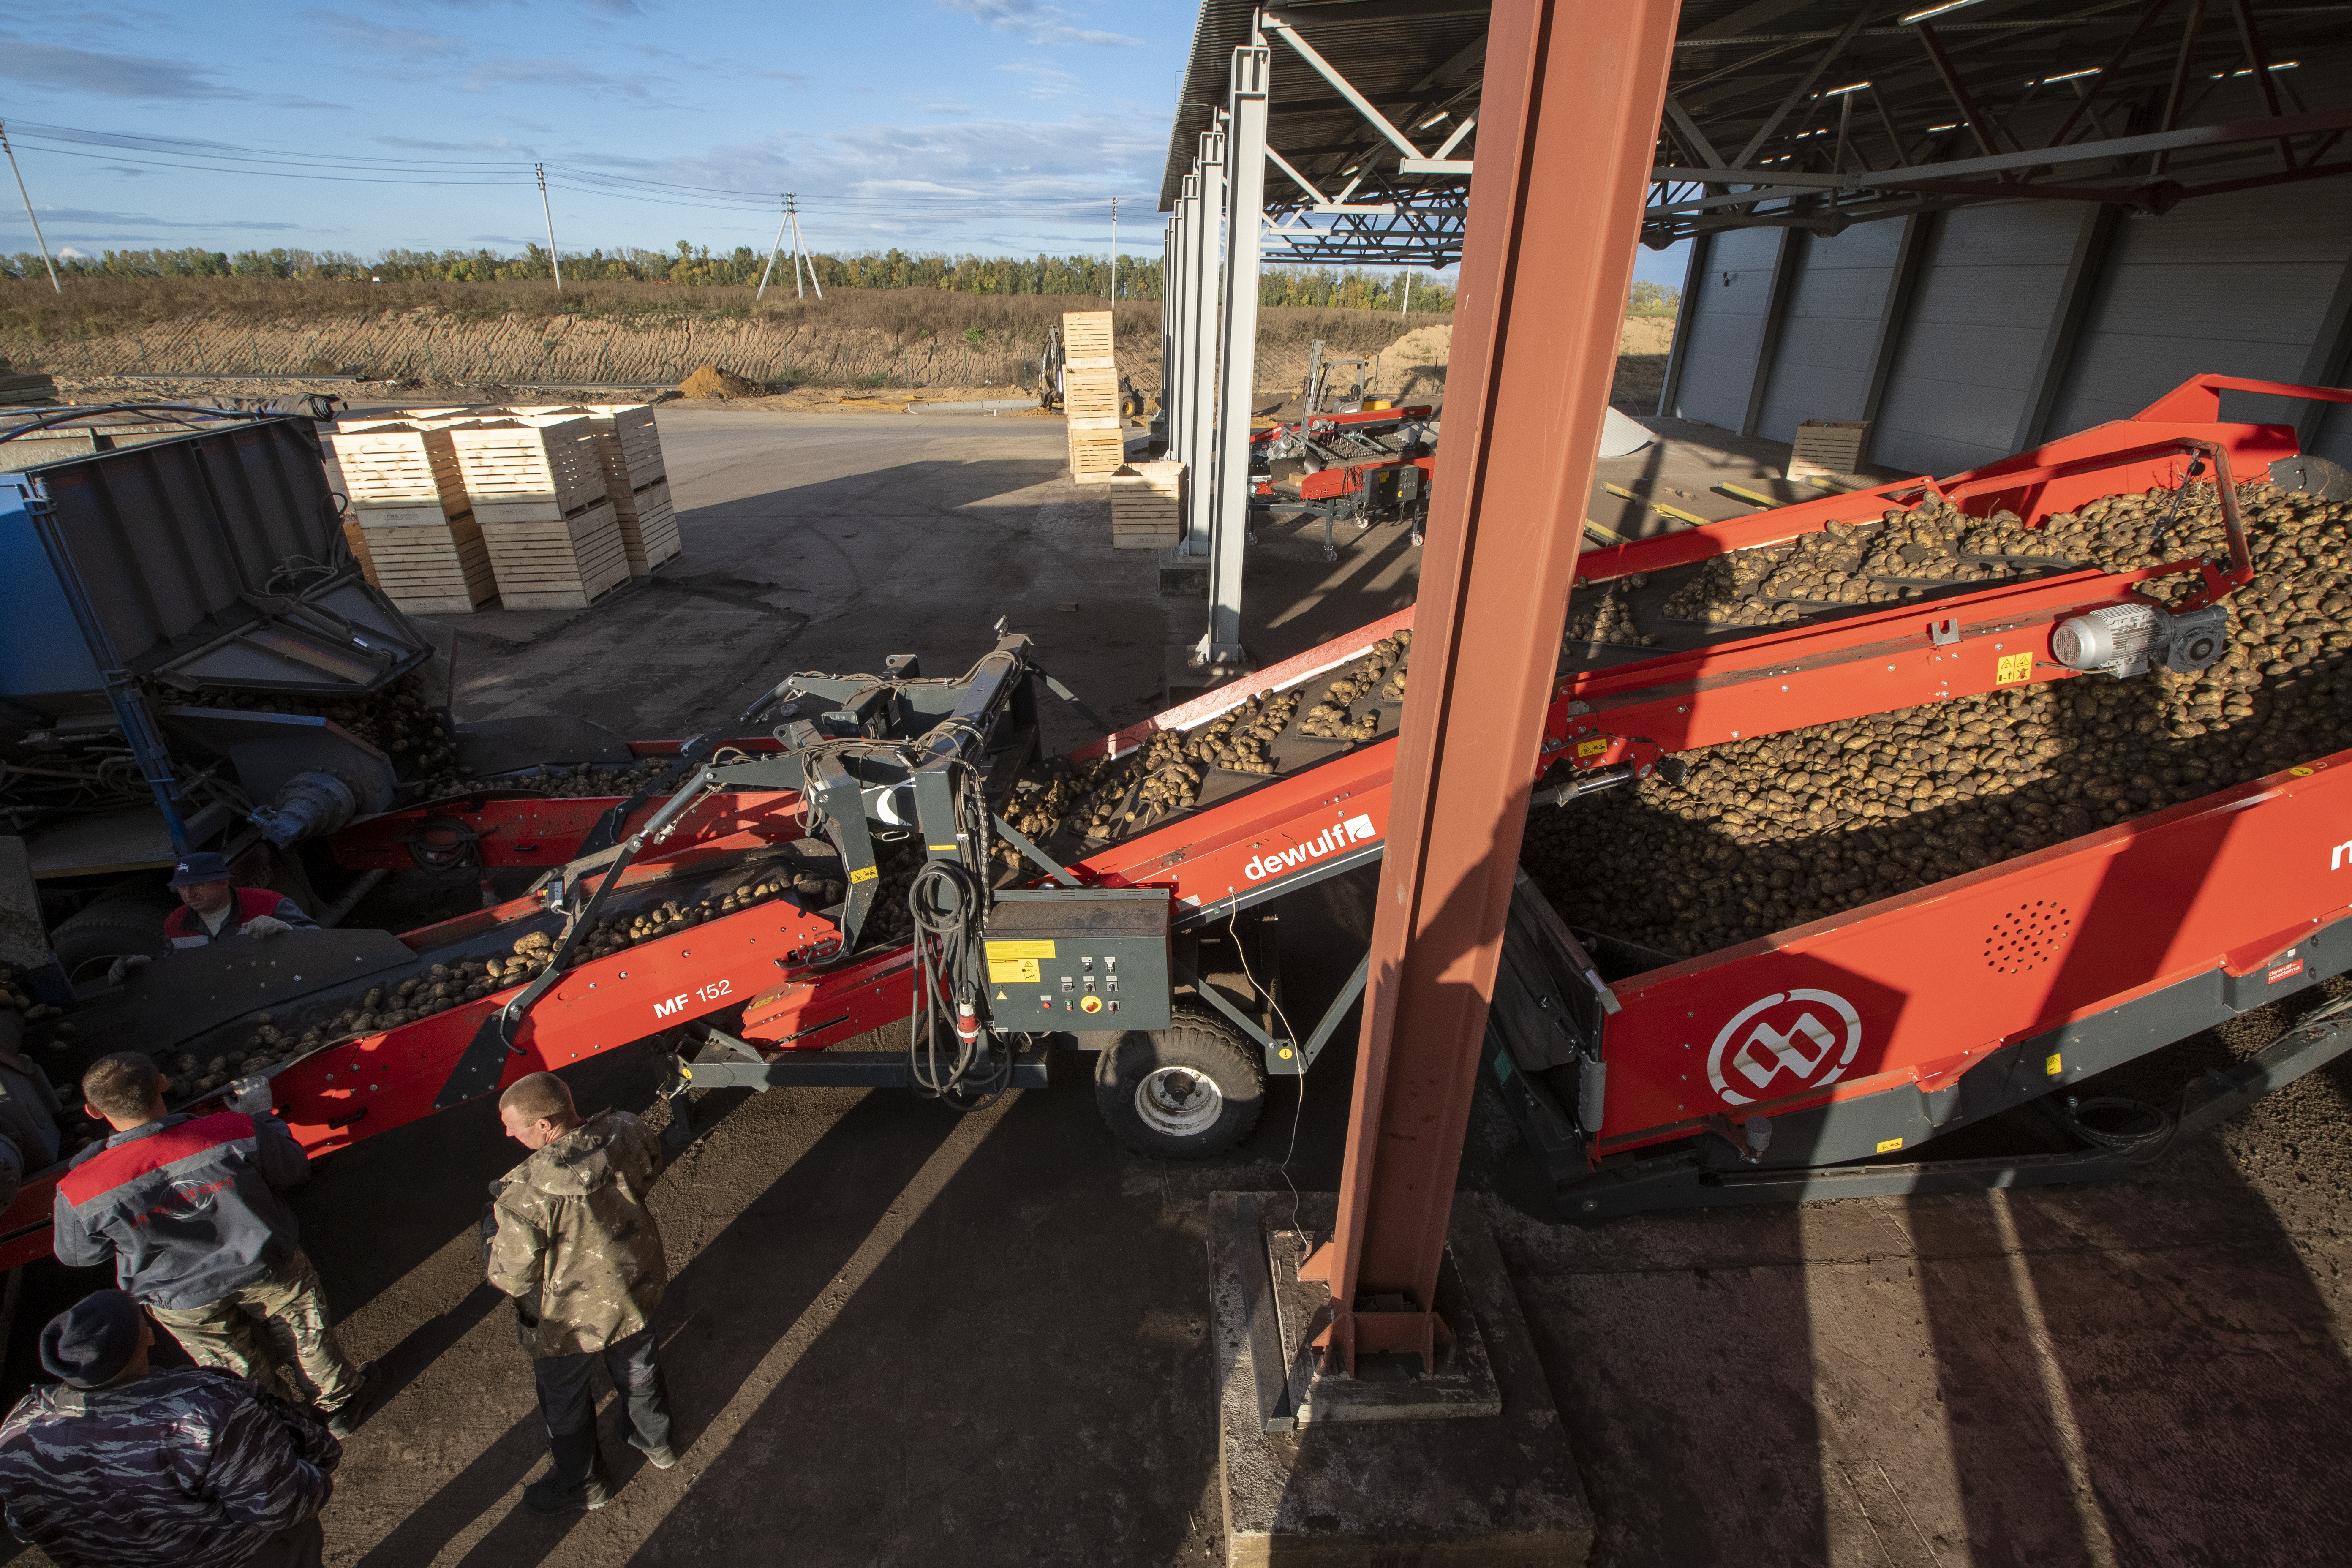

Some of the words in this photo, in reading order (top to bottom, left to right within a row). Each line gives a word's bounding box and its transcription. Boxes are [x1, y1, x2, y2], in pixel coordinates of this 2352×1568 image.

[1244, 823, 1347, 881] dewulf
[2269, 966, 2300, 981] miedema
[653, 993, 689, 1018] MF
[695, 979, 732, 1002] 152
